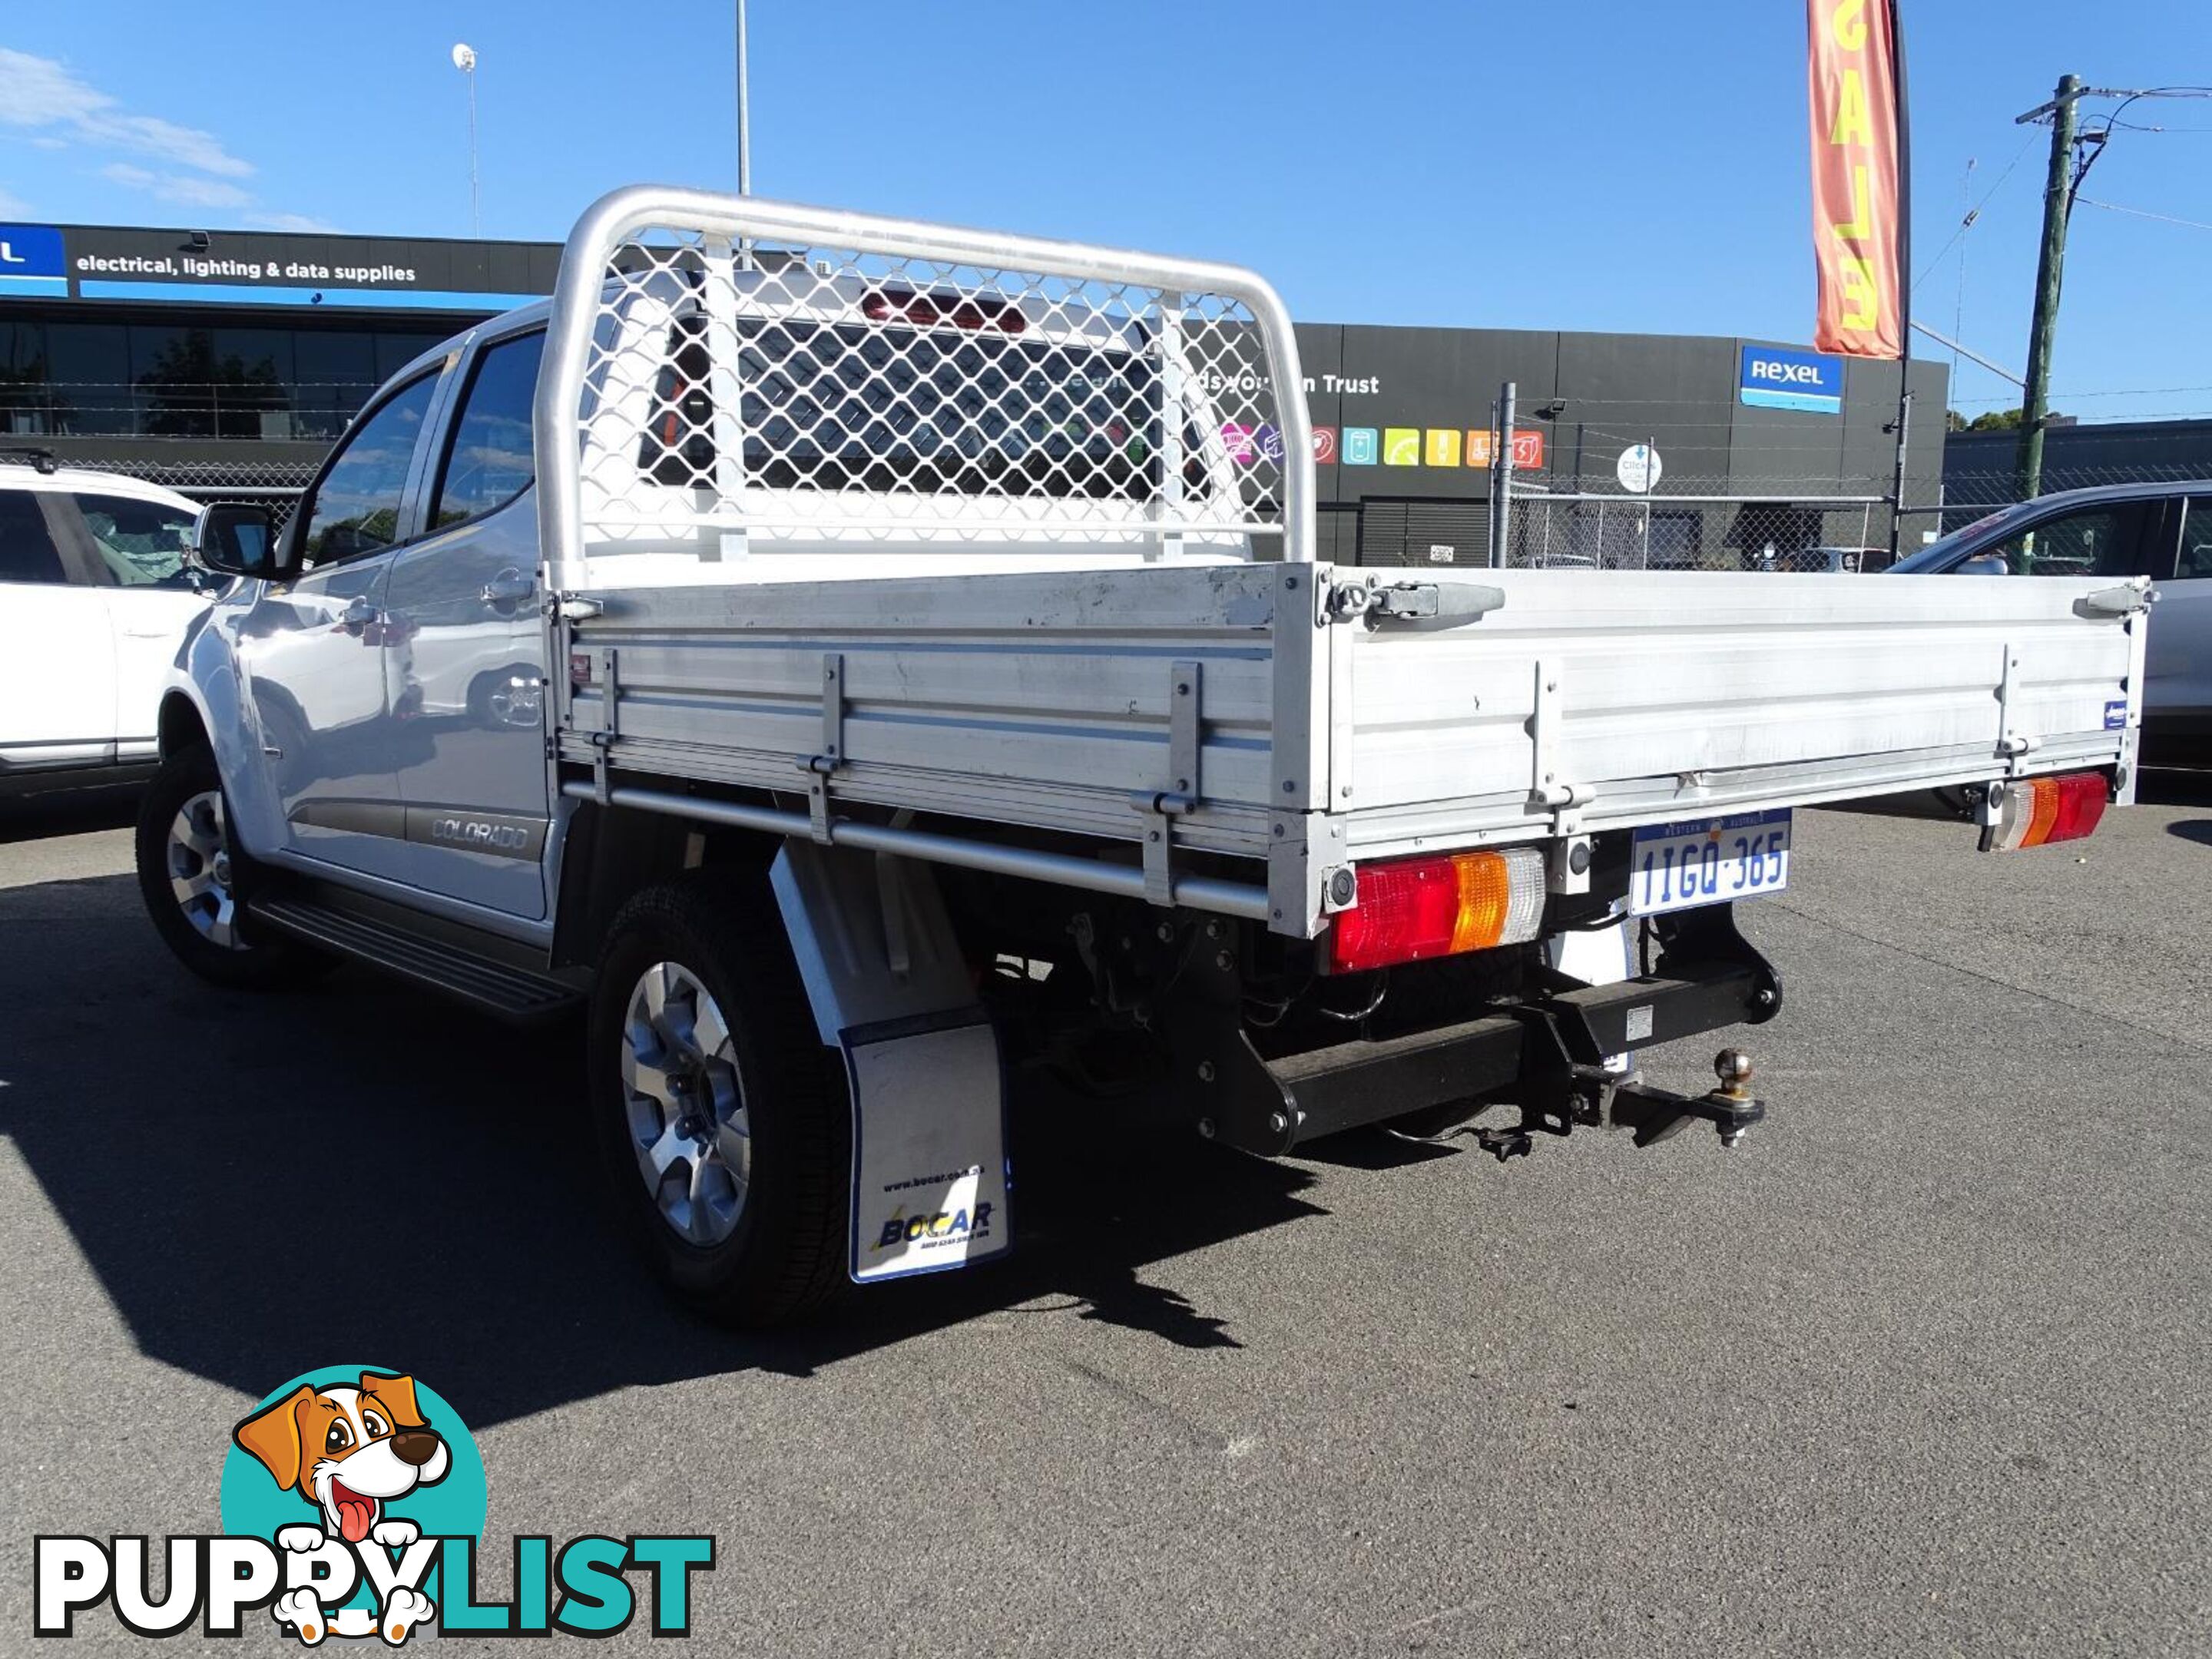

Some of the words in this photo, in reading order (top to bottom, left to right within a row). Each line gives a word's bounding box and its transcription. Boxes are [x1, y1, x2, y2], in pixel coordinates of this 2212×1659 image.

[77, 255, 178, 275] electrical,
[184, 258, 260, 278] lighting
[266, 262, 280, 276] &
[286, 262, 329, 279] data
[335, 265, 416, 283] supplies
[1323, 374, 1379, 393] Trust
[432, 819, 528, 849] COLORADO
[879, 1202, 994, 1247] BOCAR
